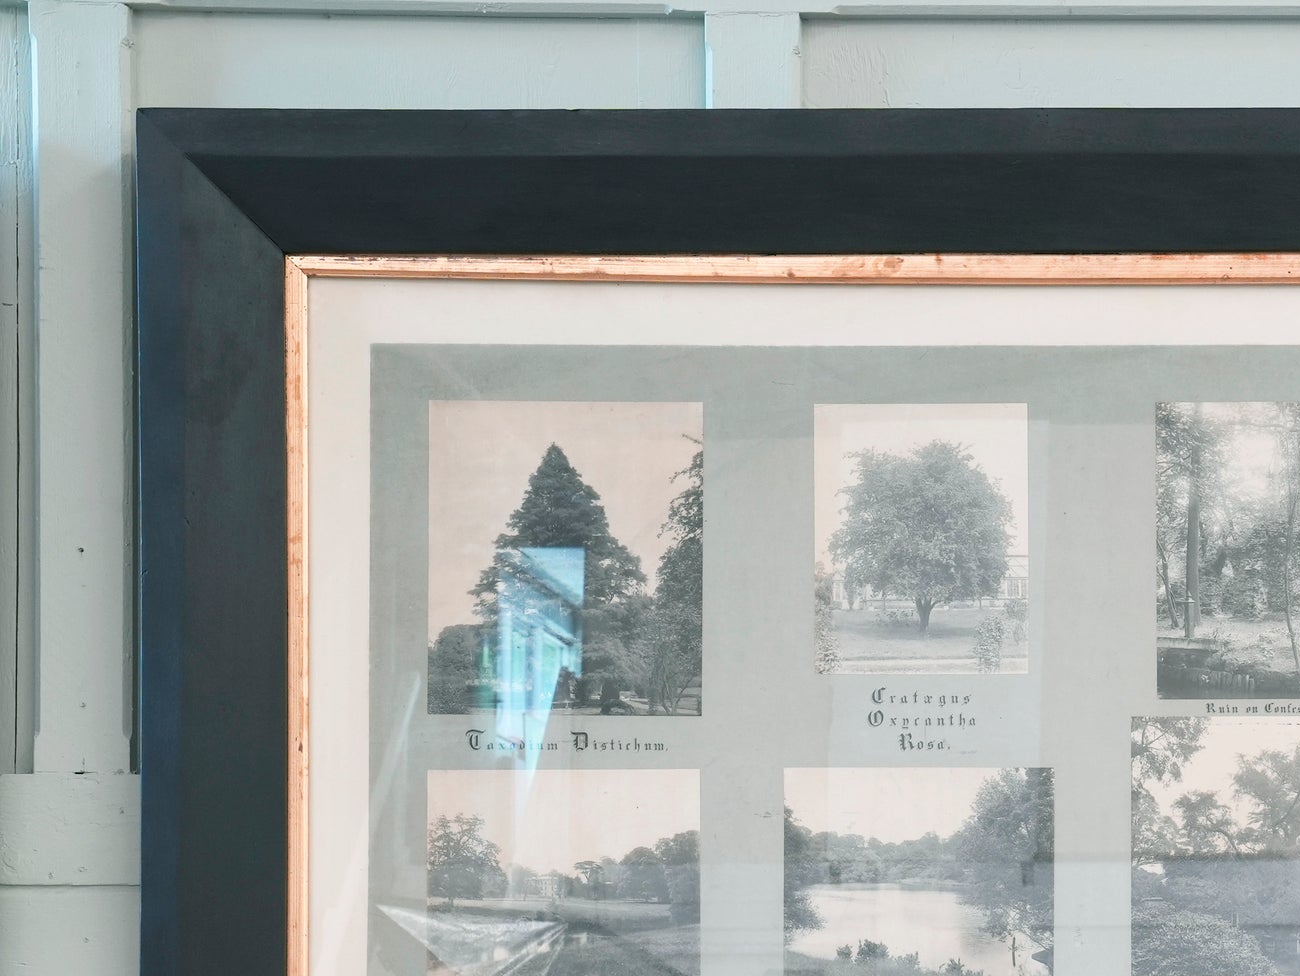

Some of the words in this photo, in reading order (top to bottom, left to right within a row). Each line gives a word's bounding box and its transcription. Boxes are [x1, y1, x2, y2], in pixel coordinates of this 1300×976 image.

[1206, 702, 1239, 714] Ruin
[1246, 703, 1258, 713] on
[867, 709, 976, 730] Oxycantha
[899, 733, 951, 751] Rosa.
